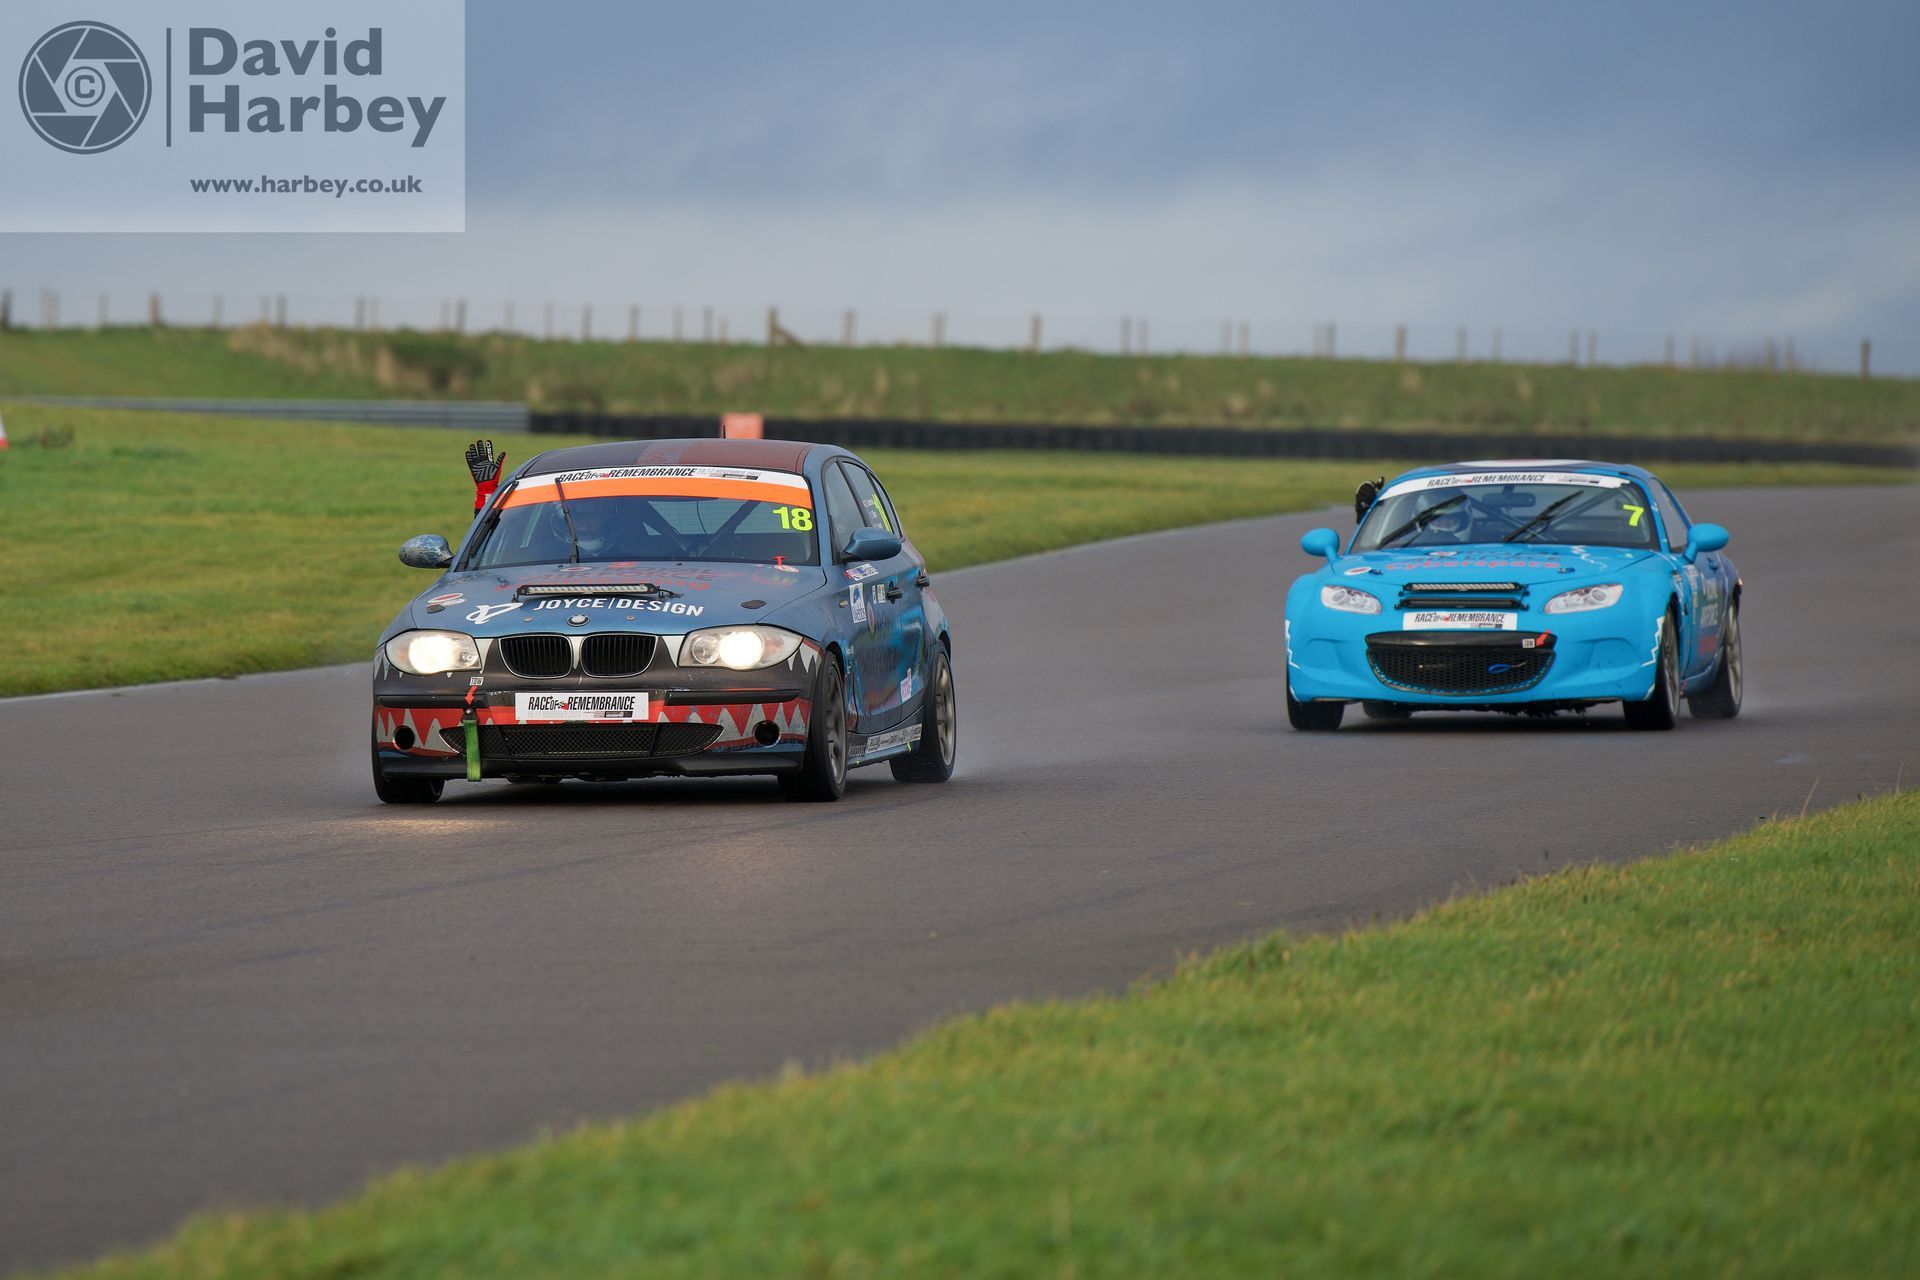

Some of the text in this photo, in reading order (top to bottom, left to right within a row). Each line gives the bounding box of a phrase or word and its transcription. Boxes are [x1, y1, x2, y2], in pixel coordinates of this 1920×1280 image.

[608, 468, 698, 478] REMEMBRANCE
[1427, 479, 1451, 488] RACE
[1471, 474, 1546, 483] REMEMBRANCE
[772, 506, 813, 531] 18
[1622, 504, 1644, 527] 7
[533, 598, 705, 617] JOYCE DESIGN
[1415, 613, 1435, 623] RACE
[1448, 612, 1506, 623] REMEMBRANCE
[528, 696, 551, 711] RACE
[567, 696, 636, 711] REMEMBRANCE
